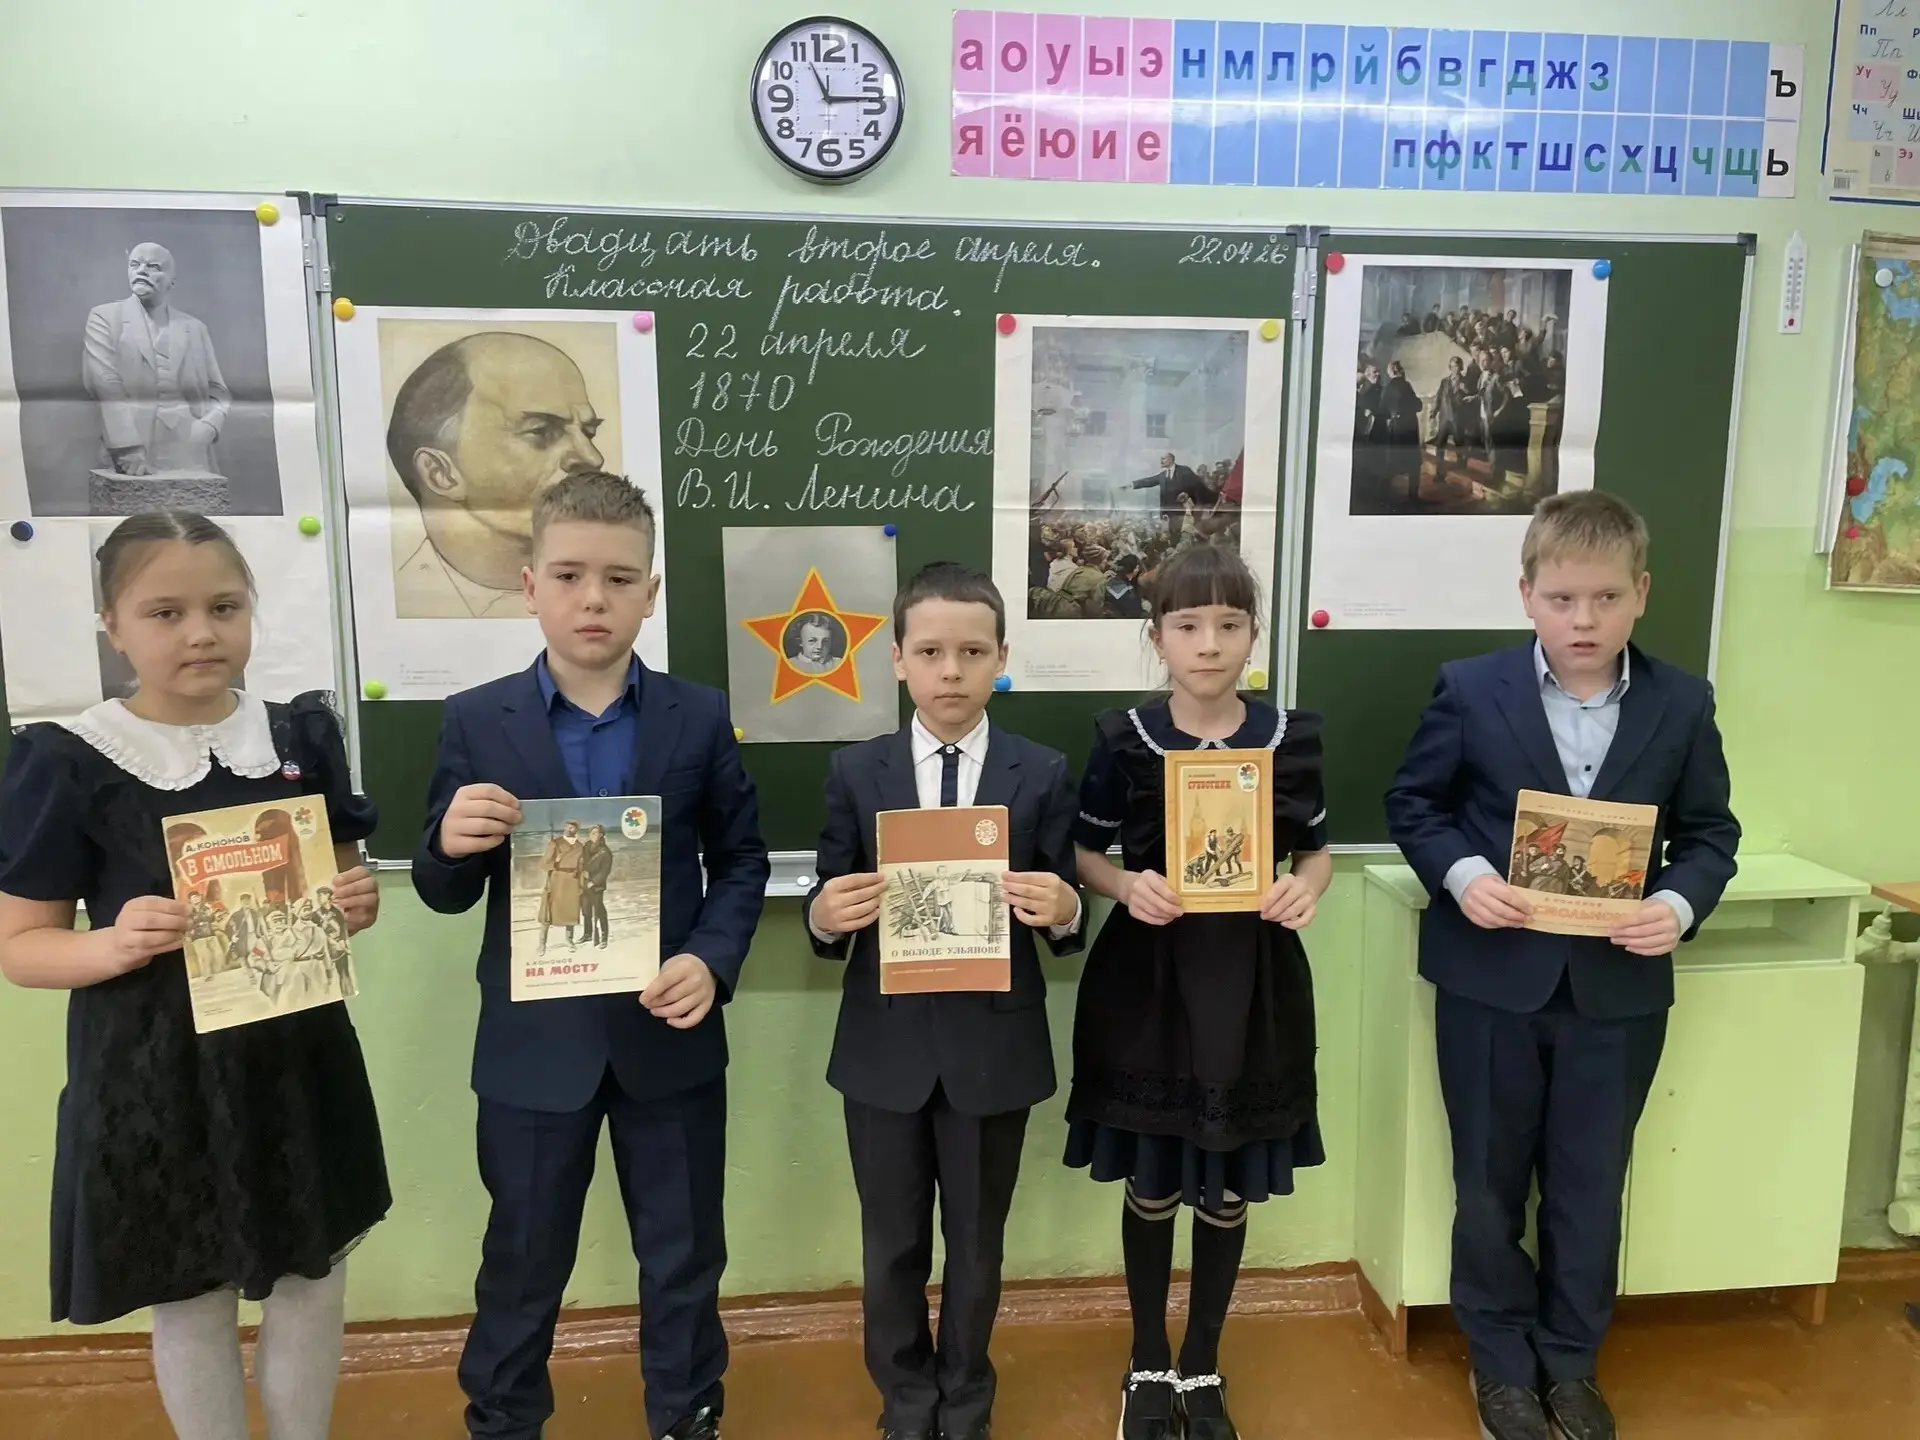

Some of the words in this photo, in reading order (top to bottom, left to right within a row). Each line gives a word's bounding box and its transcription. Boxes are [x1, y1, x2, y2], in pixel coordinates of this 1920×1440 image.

[791, 42, 807, 62] 11
[811, 34, 846, 63] 12
[851, 43, 859, 63] 1
[772, 61, 793, 80] 10
[862, 63, 879, 82] 2
[767, 84, 794, 113] 9
[863, 86, 887, 115] 3
[777, 118, 795, 139] 8
[864, 120, 882, 141] 4
[796, 138, 812, 158] 7
[817, 139, 843, 167] 6
[849, 139, 866, 159] 5
[504, 216, 759, 271] Двадцать
[787, 225, 937, 282] второе
[955, 235, 1101, 294] апреля.
[544, 263, 752, 300] Классная
[768, 272, 962, 331] работа.
[686, 322, 738, 359] 22
[761, 328, 927, 385] апреля
[688, 370, 796, 412] 1870
[674, 416, 779, 459] День
[815, 411, 994, 478] Рождения
[785, 463, 976, 513] Ленина
[185, 858, 199, 877] В
[203, 842, 283, 873] СМОЛЬНОМ
[891, 949, 899, 957] О
[902, 947, 942, 957] ВОЛОДЕ
[947, 945, 1001, 955] УЛЬЯНОВЕ
[526, 967, 545, 977] НА
[550, 963, 599, 976] МОСТУ
